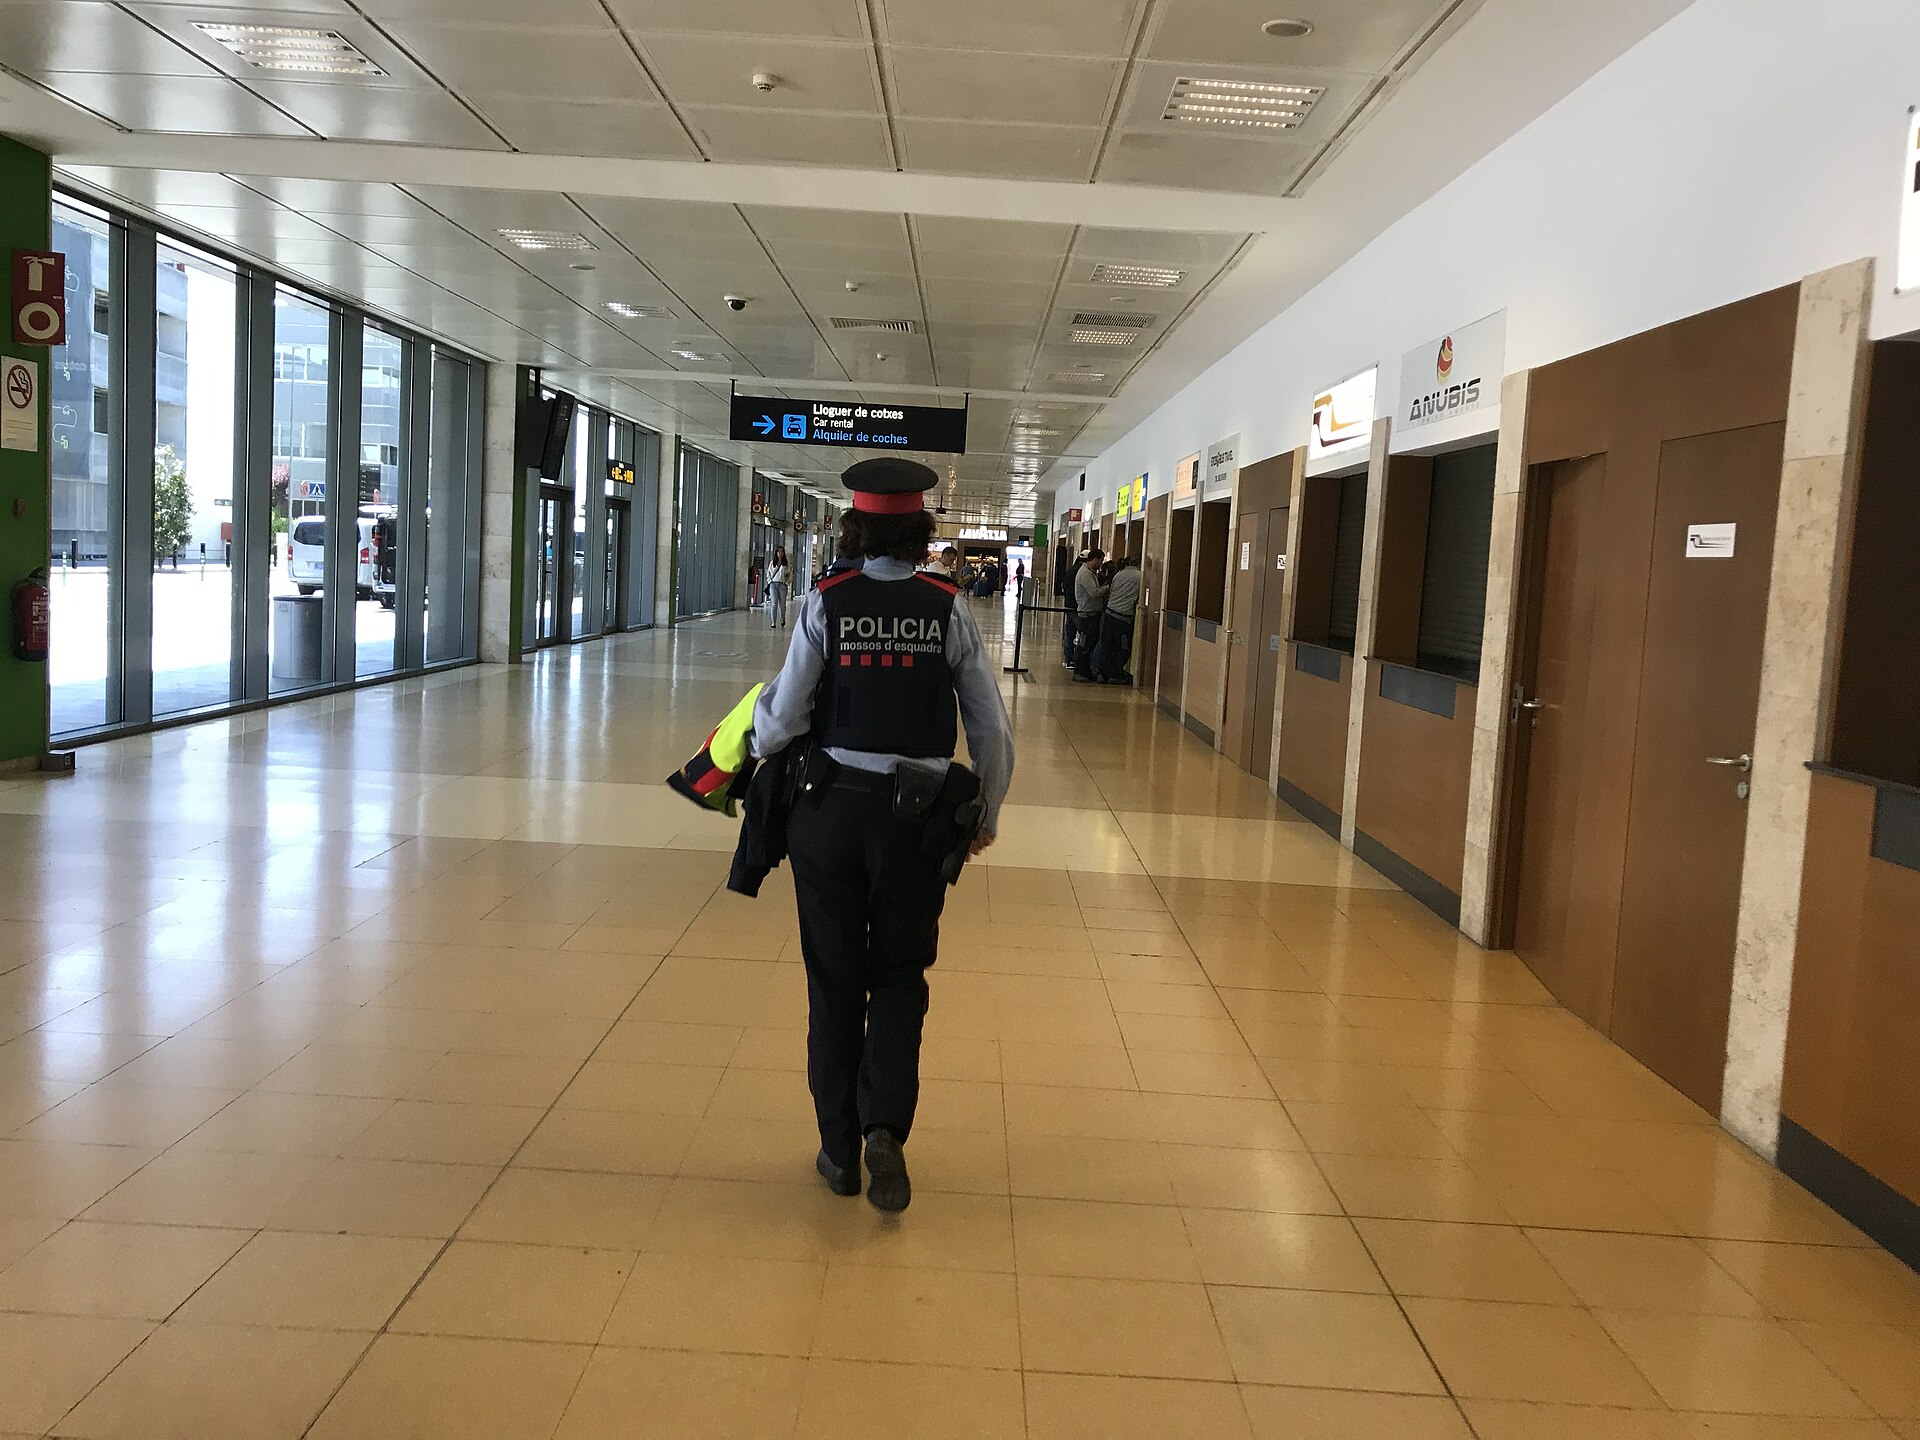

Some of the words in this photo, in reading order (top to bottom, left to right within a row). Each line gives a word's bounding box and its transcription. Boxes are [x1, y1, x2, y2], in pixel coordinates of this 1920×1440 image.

[1409, 377, 1481, 421] ANUBIS
[813, 403, 852, 418] Lloguer
[854, 406, 868, 417] de
[870, 408, 904, 420] cotxes
[813, 417, 828, 427] Car
[830, 419, 854, 429] rental
[812, 428, 853, 442] Alquiler
[856, 431, 869, 442] de
[872, 433, 908, 445] coches
[839, 616, 942, 641] POLICIA
[840, 641, 882, 651] mossos
